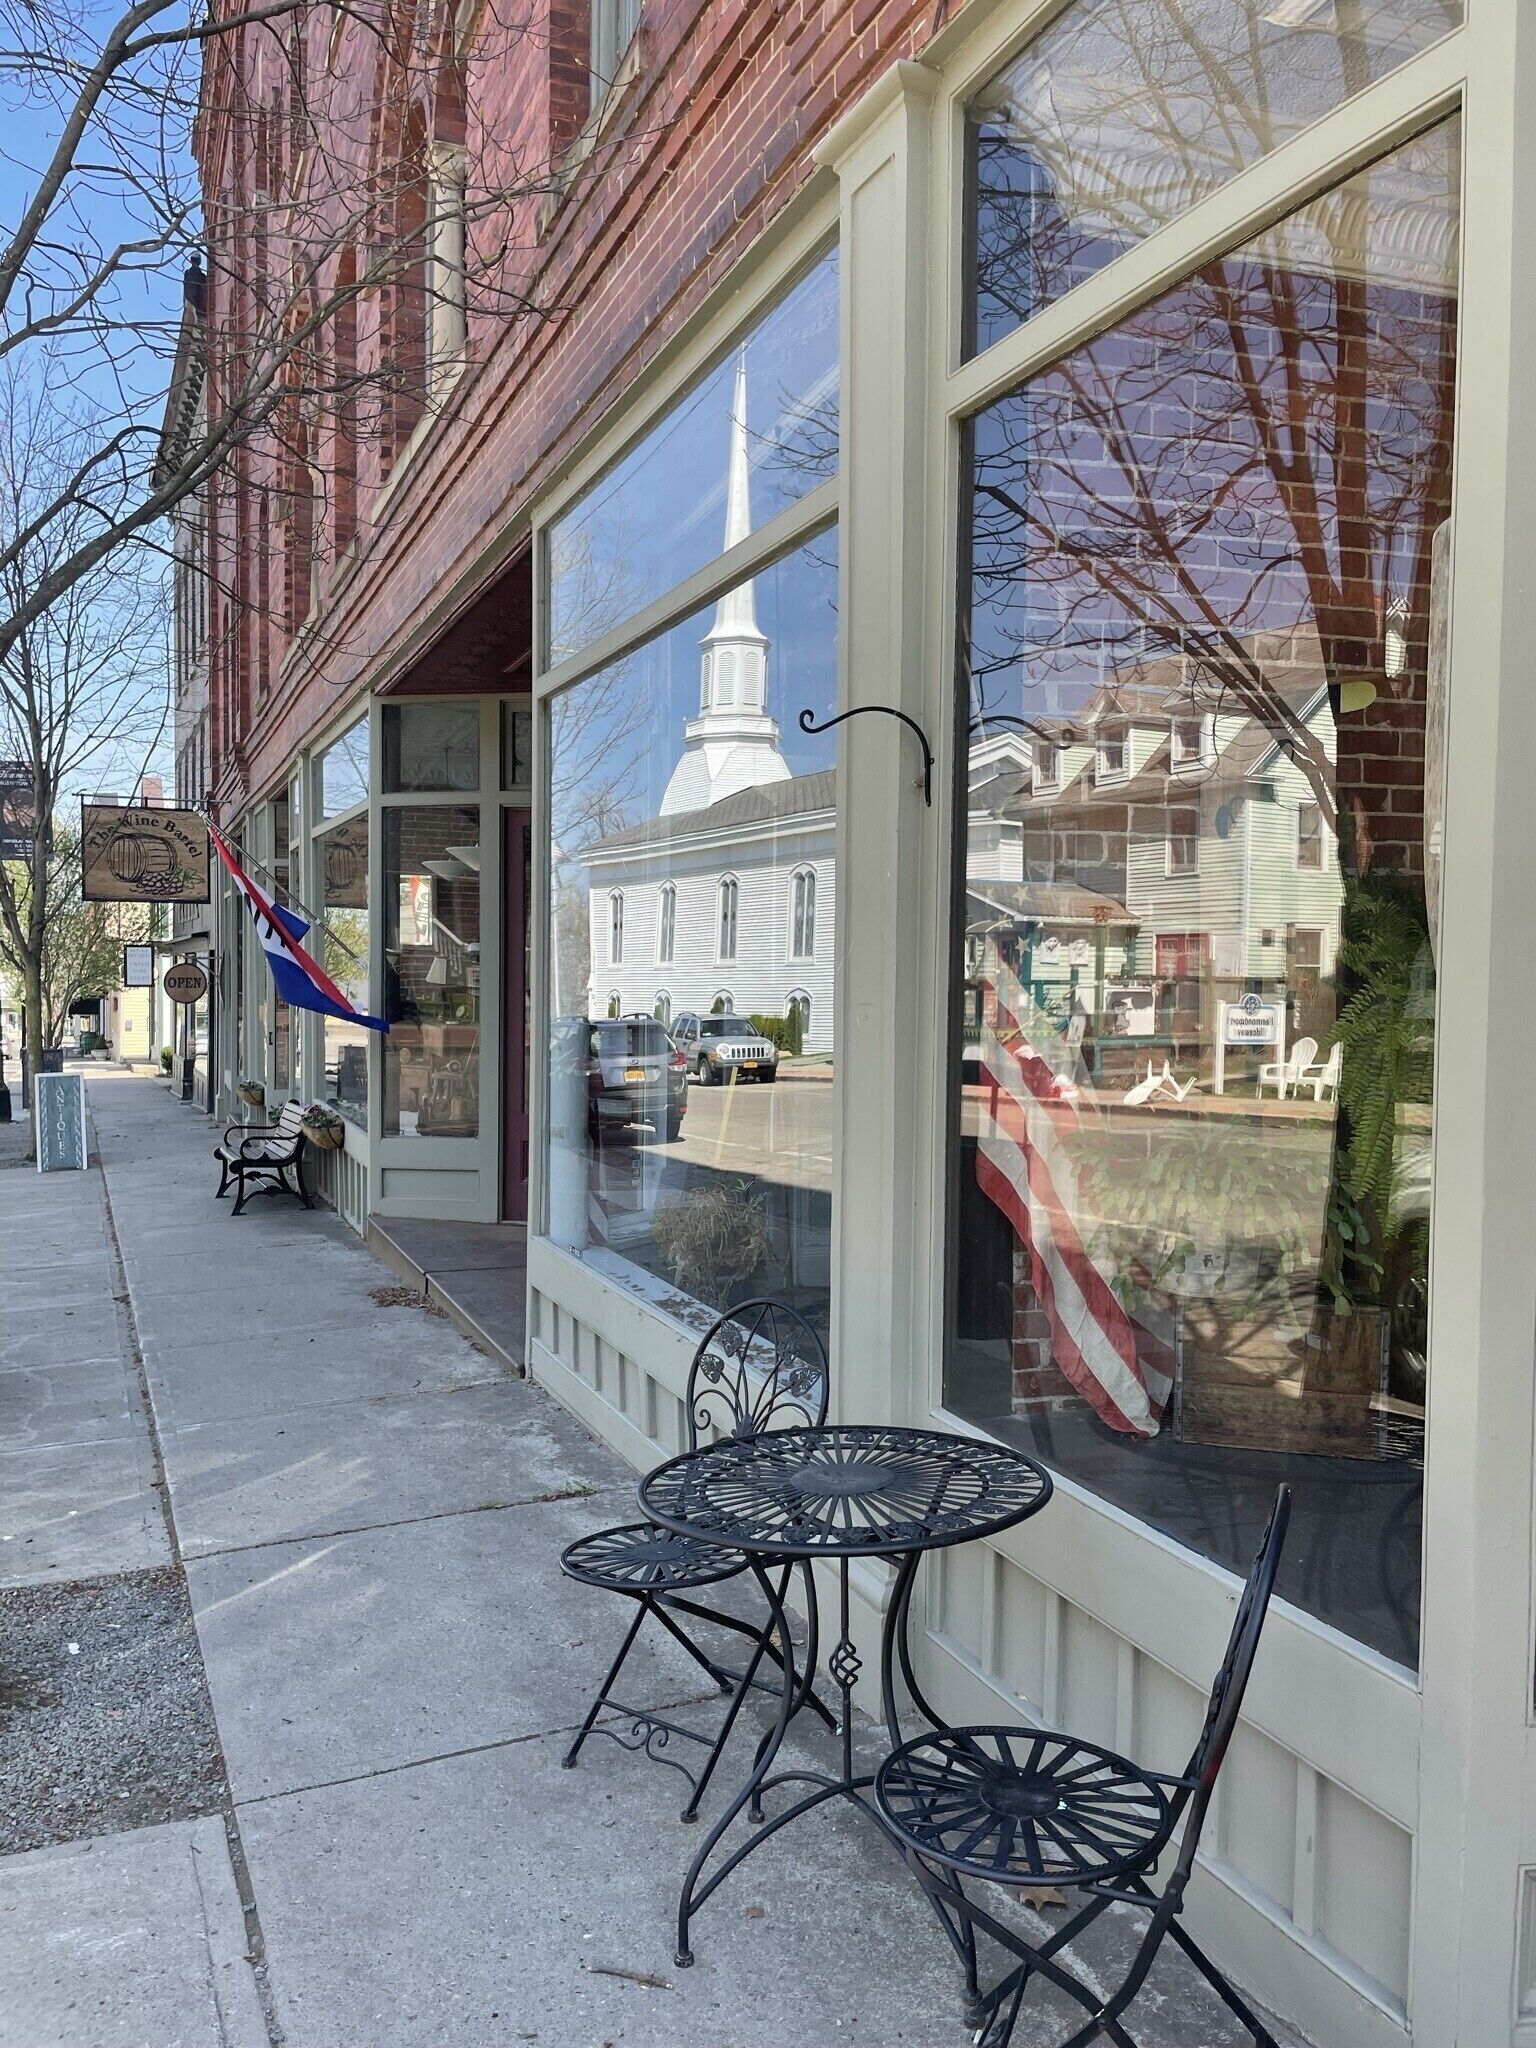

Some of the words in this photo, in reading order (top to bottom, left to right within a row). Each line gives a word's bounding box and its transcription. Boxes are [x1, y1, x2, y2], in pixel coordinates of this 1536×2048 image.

[88, 826, 116, 849] The
[118, 814, 160, 828] Wine
[162, 820, 203, 859] Barrel
[168, 977, 202, 989] OPEN
[55, 1085, 67, 1159] ANTIQUES
